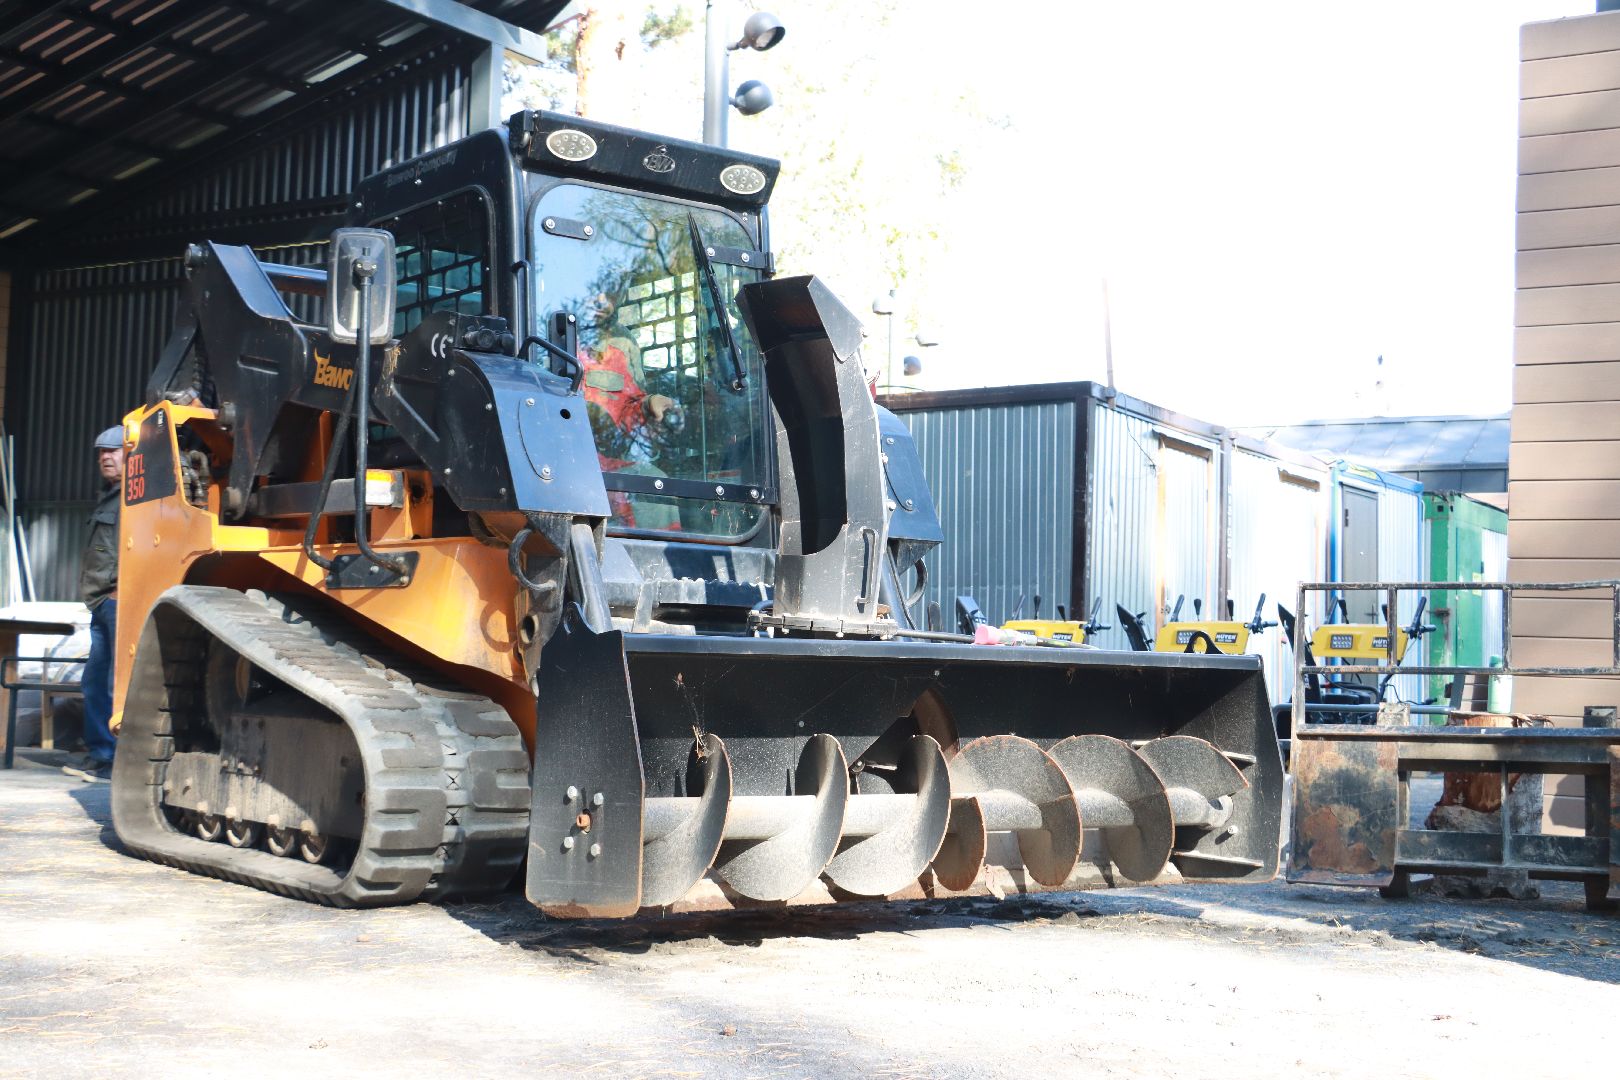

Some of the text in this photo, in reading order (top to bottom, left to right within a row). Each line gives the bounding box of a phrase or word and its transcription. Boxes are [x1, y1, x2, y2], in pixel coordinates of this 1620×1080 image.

[313, 348, 353, 390] Bawo
[128, 453, 144, 478] BTL
[128, 477, 145, 500] 350
